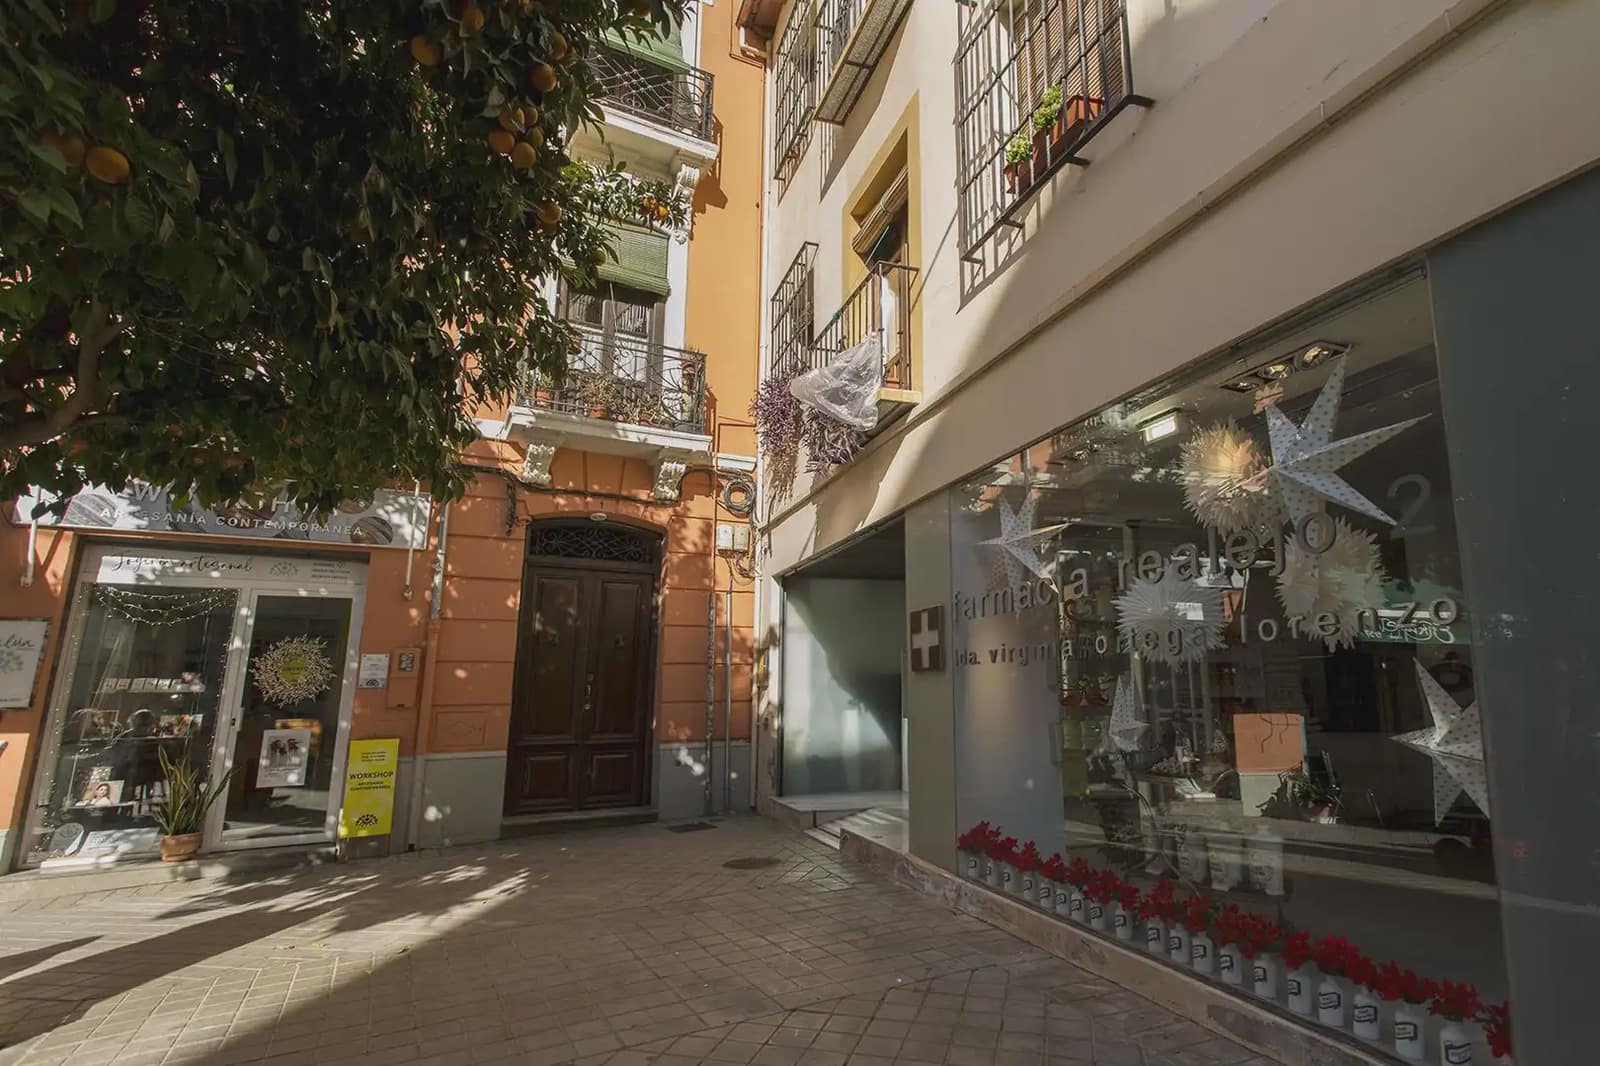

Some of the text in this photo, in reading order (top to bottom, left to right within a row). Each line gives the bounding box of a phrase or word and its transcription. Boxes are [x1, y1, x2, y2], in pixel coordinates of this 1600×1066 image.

[953, 512, 1337, 622] farmacia realejo
[1239, 597, 1458, 644] lorenzo
[350, 770, 394, 780] WORKSHOP
